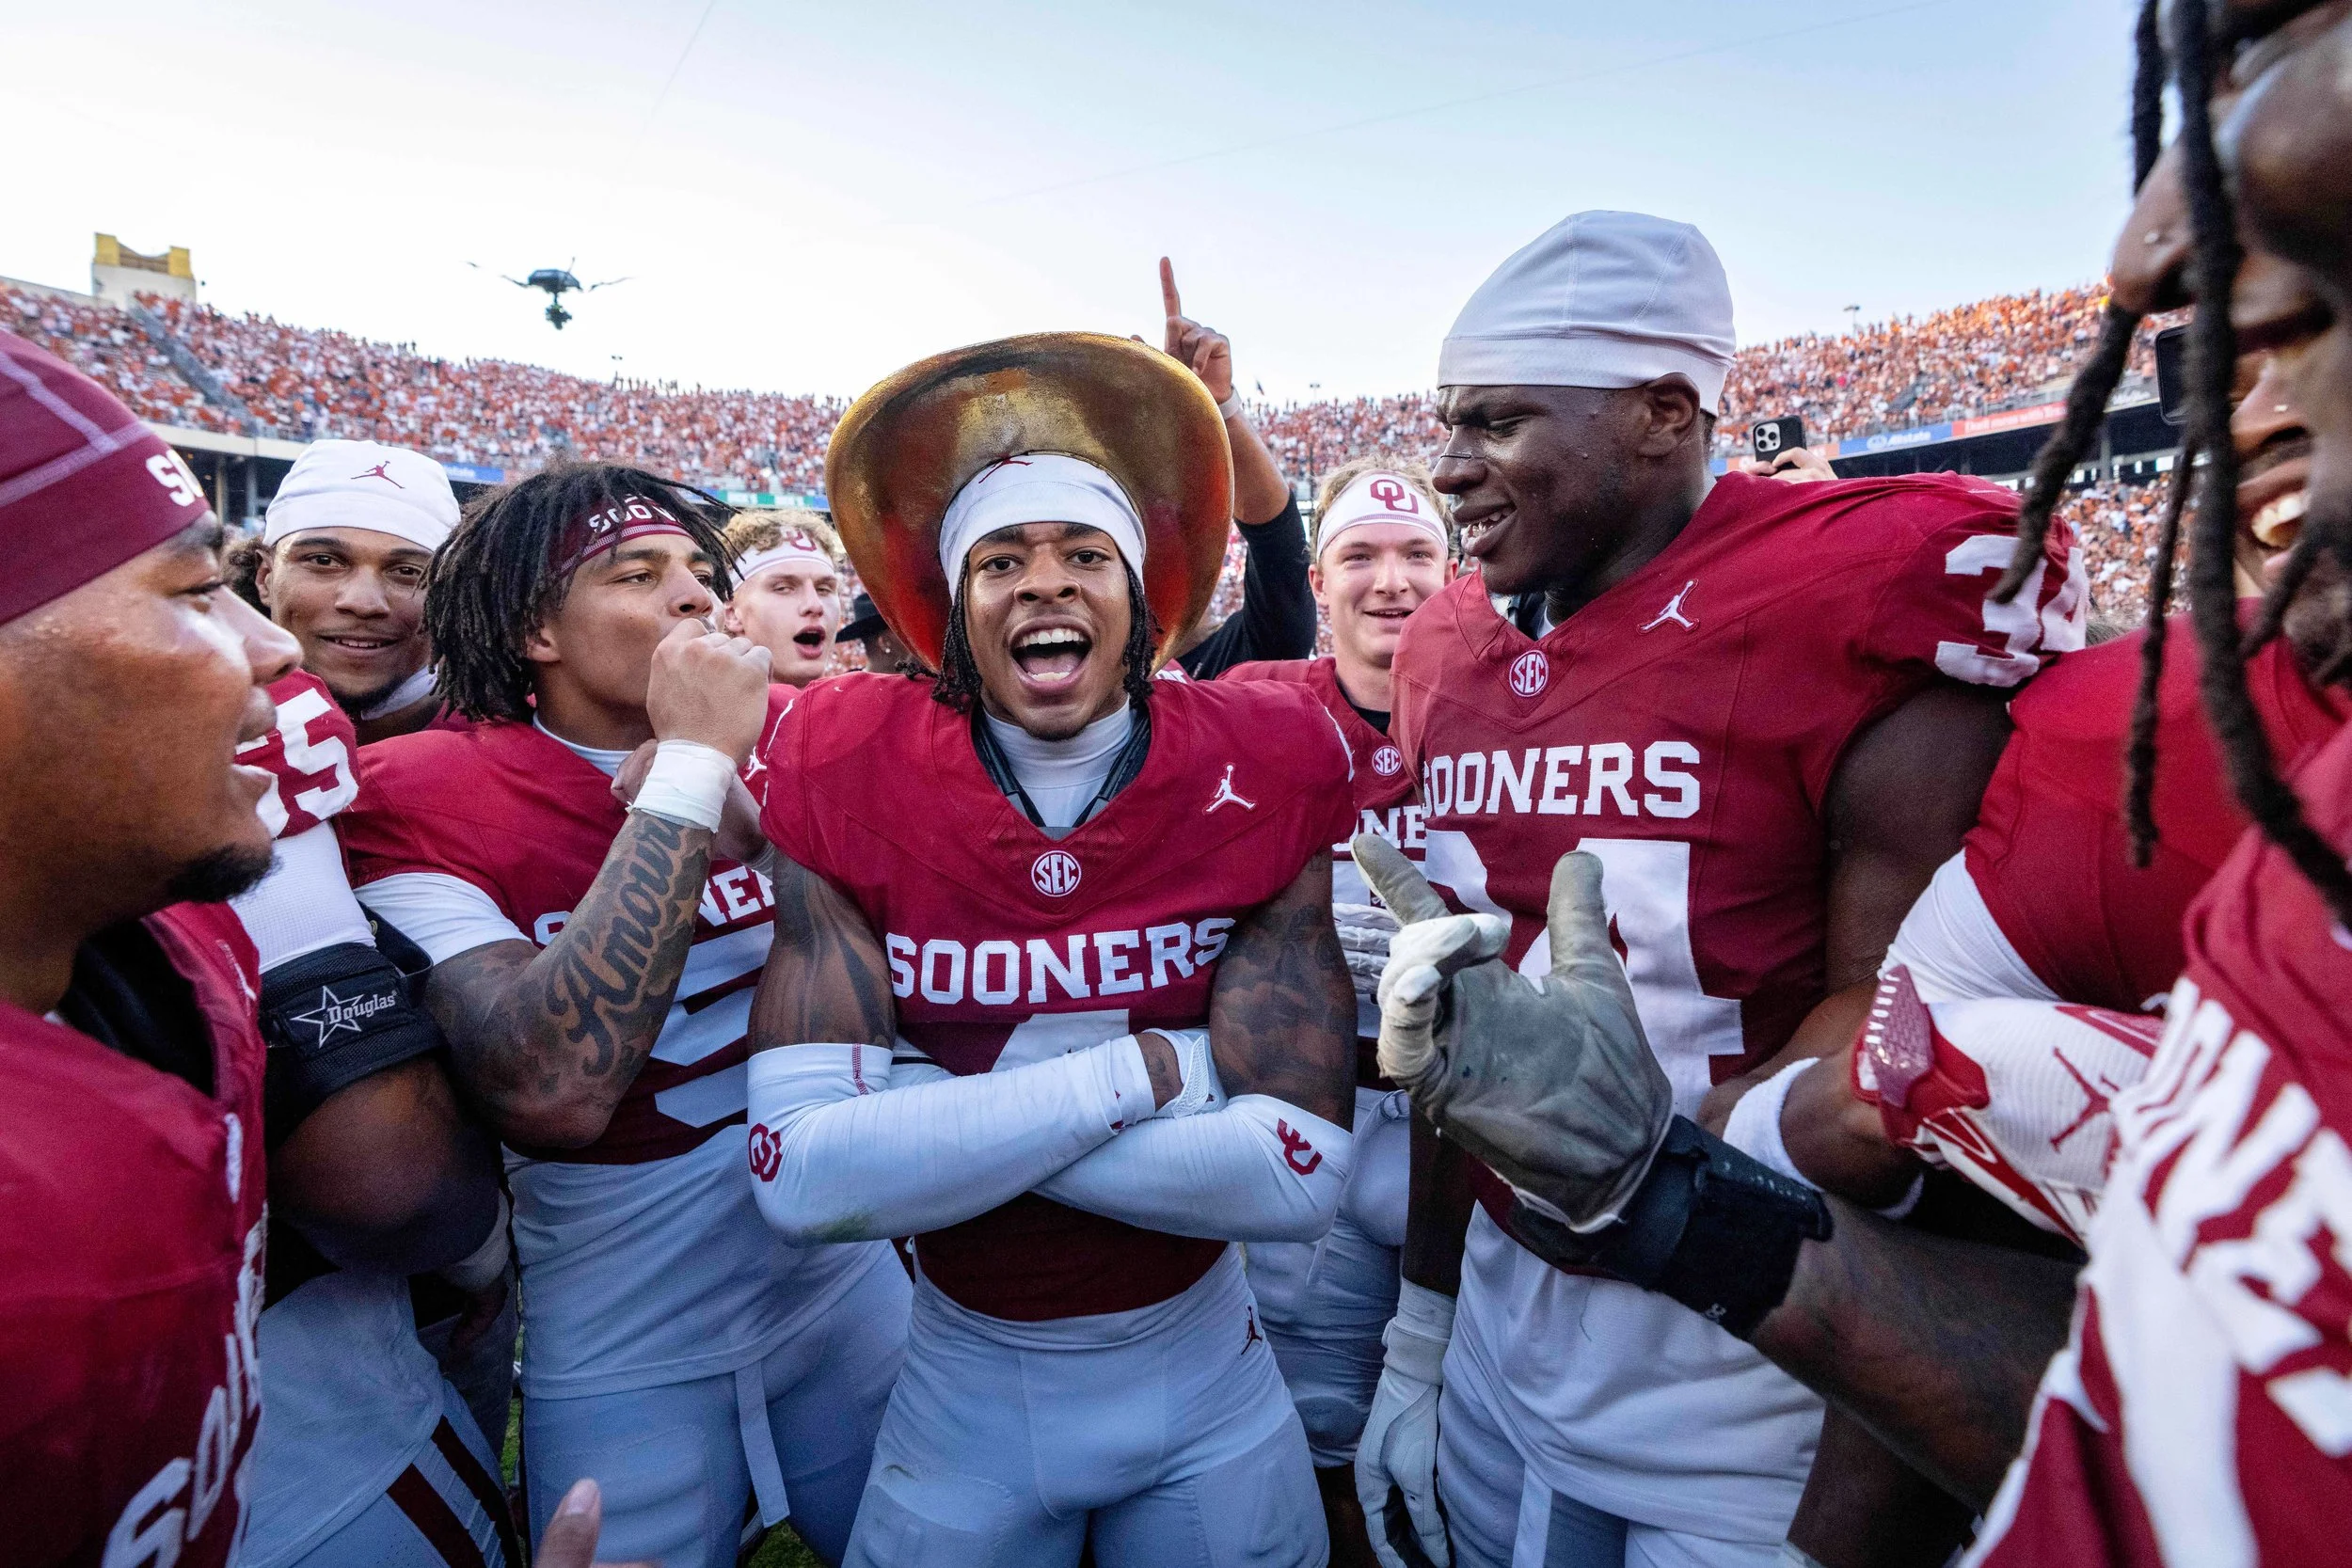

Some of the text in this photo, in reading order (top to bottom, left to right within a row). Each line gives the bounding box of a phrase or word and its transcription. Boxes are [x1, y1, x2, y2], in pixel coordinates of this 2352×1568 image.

[1370, 479, 1419, 515] OU
[1514, 653, 1545, 693] SEC
[1375, 748, 1400, 774] SEC
[1036, 853, 1077, 894] SEC
[885, 917, 1235, 1006] SOONERS
[326, 993, 396, 1024] Douglas
